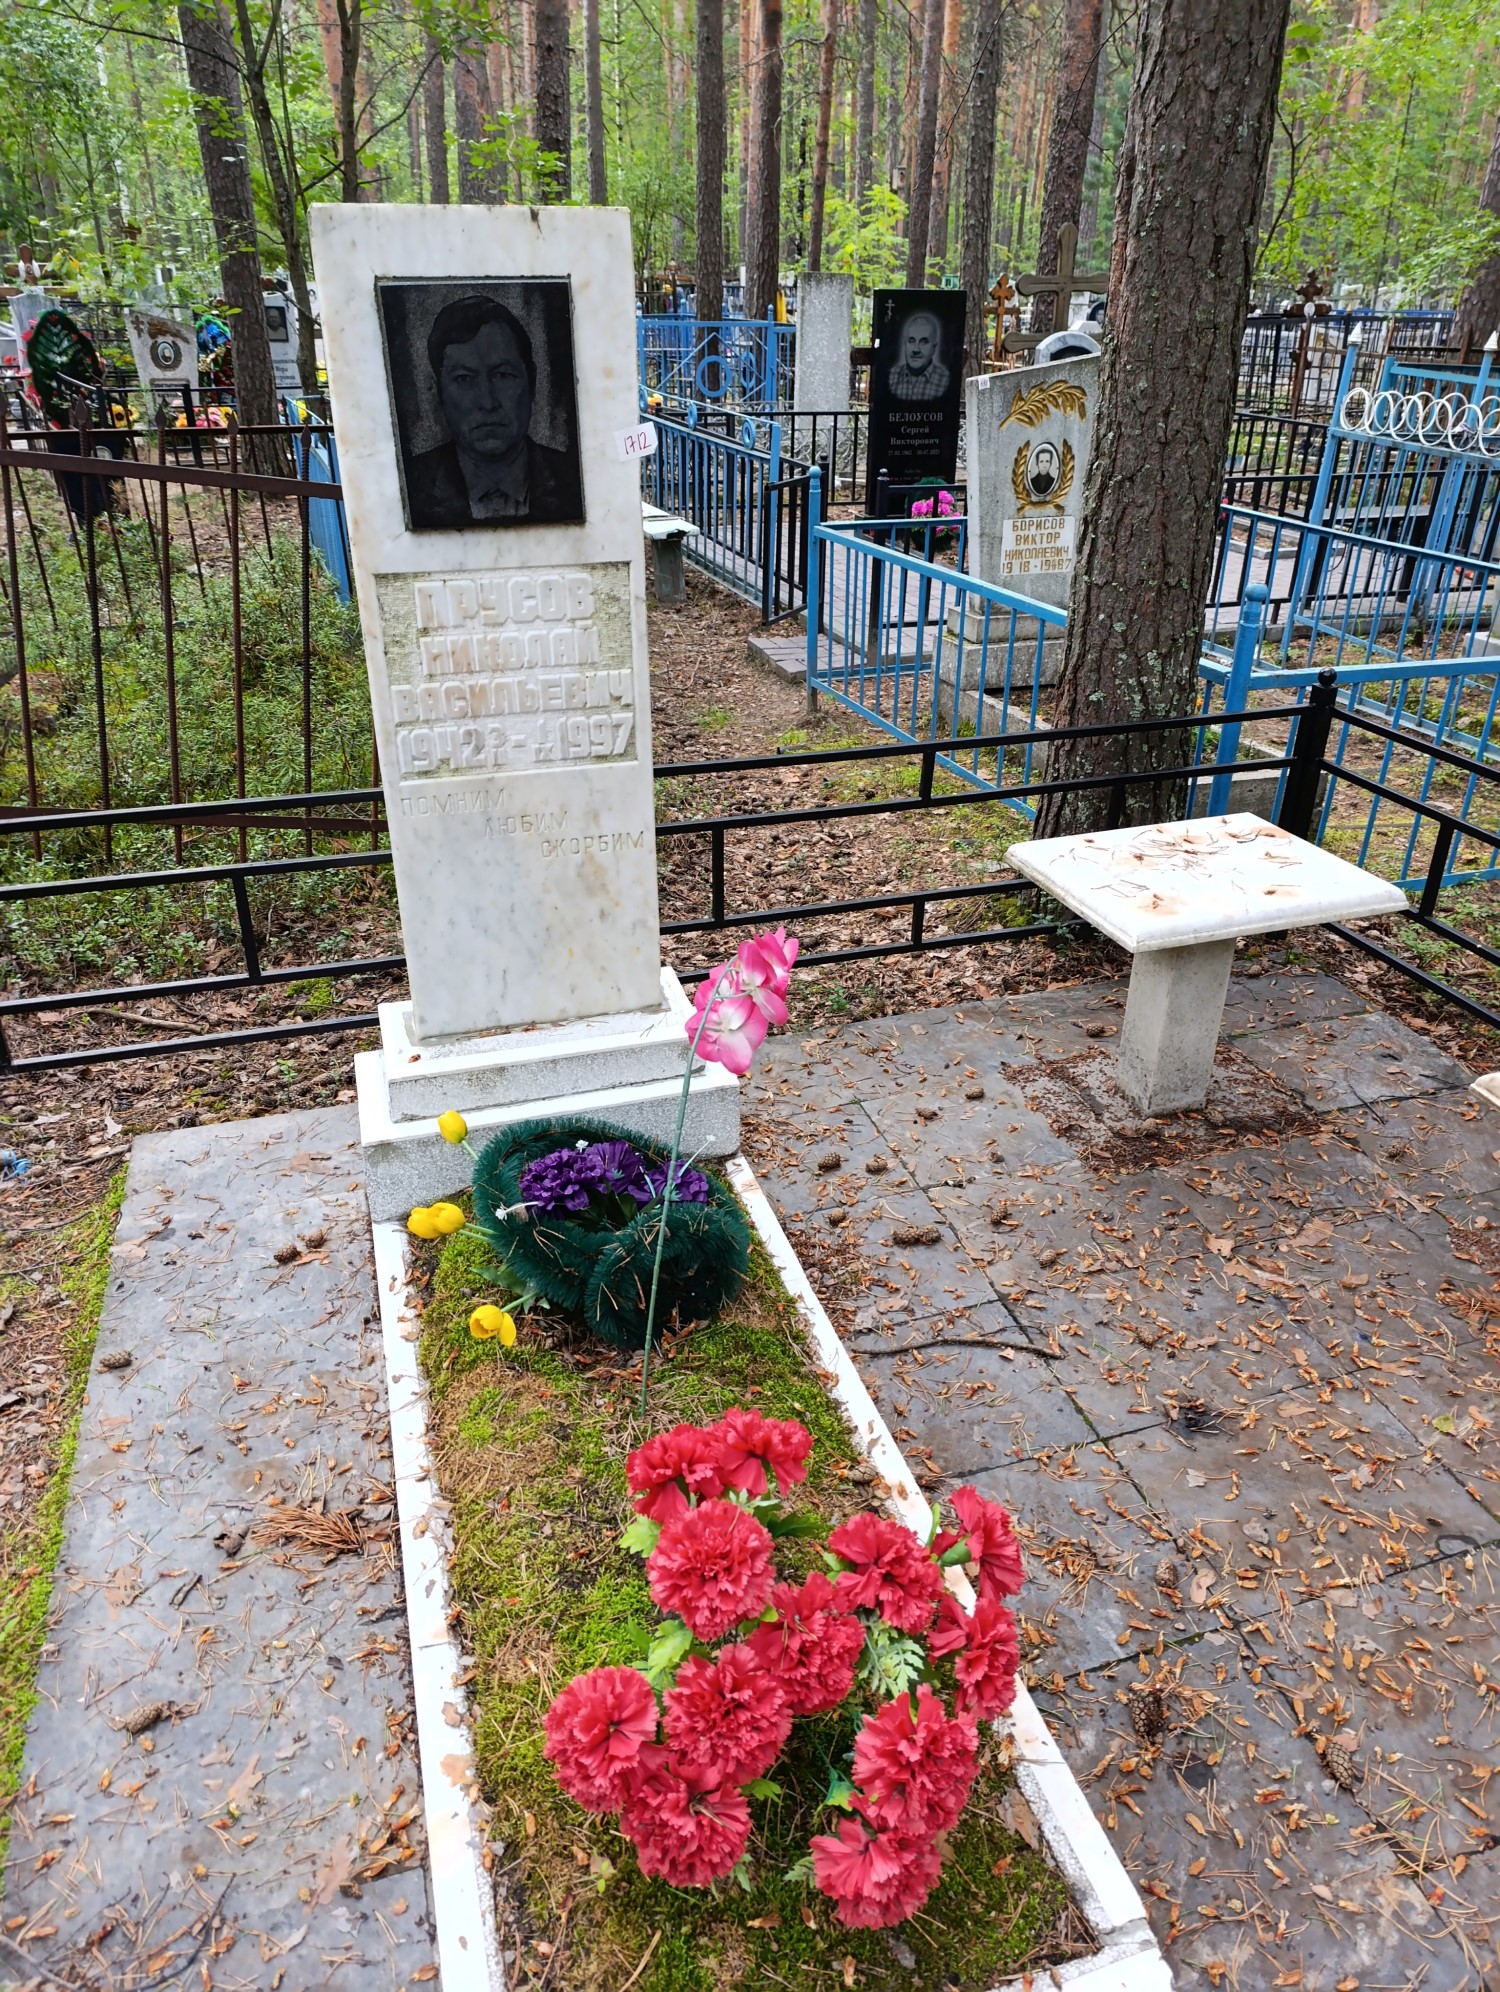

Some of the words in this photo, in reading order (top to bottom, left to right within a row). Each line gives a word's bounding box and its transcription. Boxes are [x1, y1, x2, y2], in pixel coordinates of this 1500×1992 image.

[888, 412, 944, 422] БЕЛОУСОВ
[890, 437, 940, 447] Викторович
[901, 425, 930, 435] Сергей
[624, 431, 653, 455] 1712
[1012, 518, 1065, 532] БОРИСОВ
[1015, 532, 1061, 546] ВИКТОР
[1004, 546, 1070, 561] НИКОЛАЕВИЧ
[415, 572, 596, 629] ПРУСОВ
[419, 619, 599, 677] НИКОЛАЙ
[391, 669, 633, 723] ВАСИЛЬЕВИЧ
[400, 788, 507, 818] ПОМНИМ
[484, 811, 569, 839] ЛЮБИМ
[541, 830, 645, 858] СКОРБИМ
